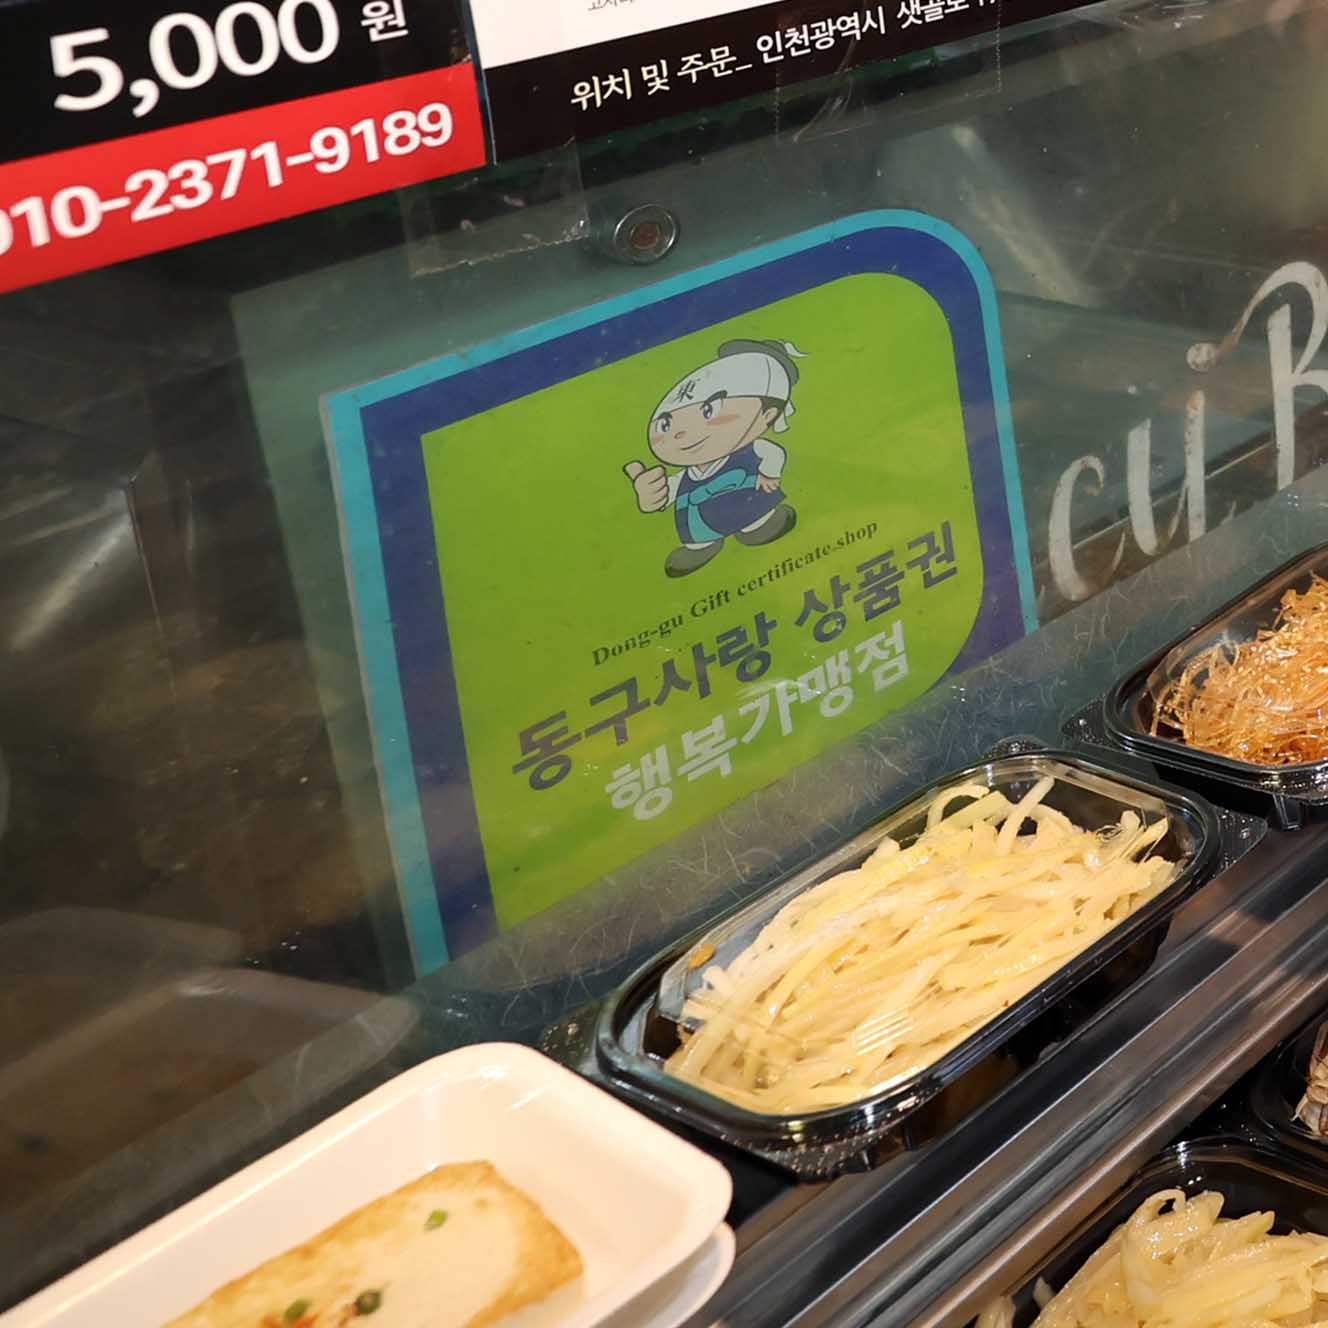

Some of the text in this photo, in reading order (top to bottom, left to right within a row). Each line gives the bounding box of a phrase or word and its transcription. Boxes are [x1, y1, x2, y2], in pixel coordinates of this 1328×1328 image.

[571, 68, 632, 112] 위치
[641, 59, 671, 96] 및
[756, 5, 886, 65] 인천광역시
[0, 102, 454, 257] 10-2371-9189
[512, 521, 958, 791] 동구사랑 상품권
[592, 521, 878, 667] Dong-gu Gift certificate shop
[604, 620, 910, 822] 행복가맹점
